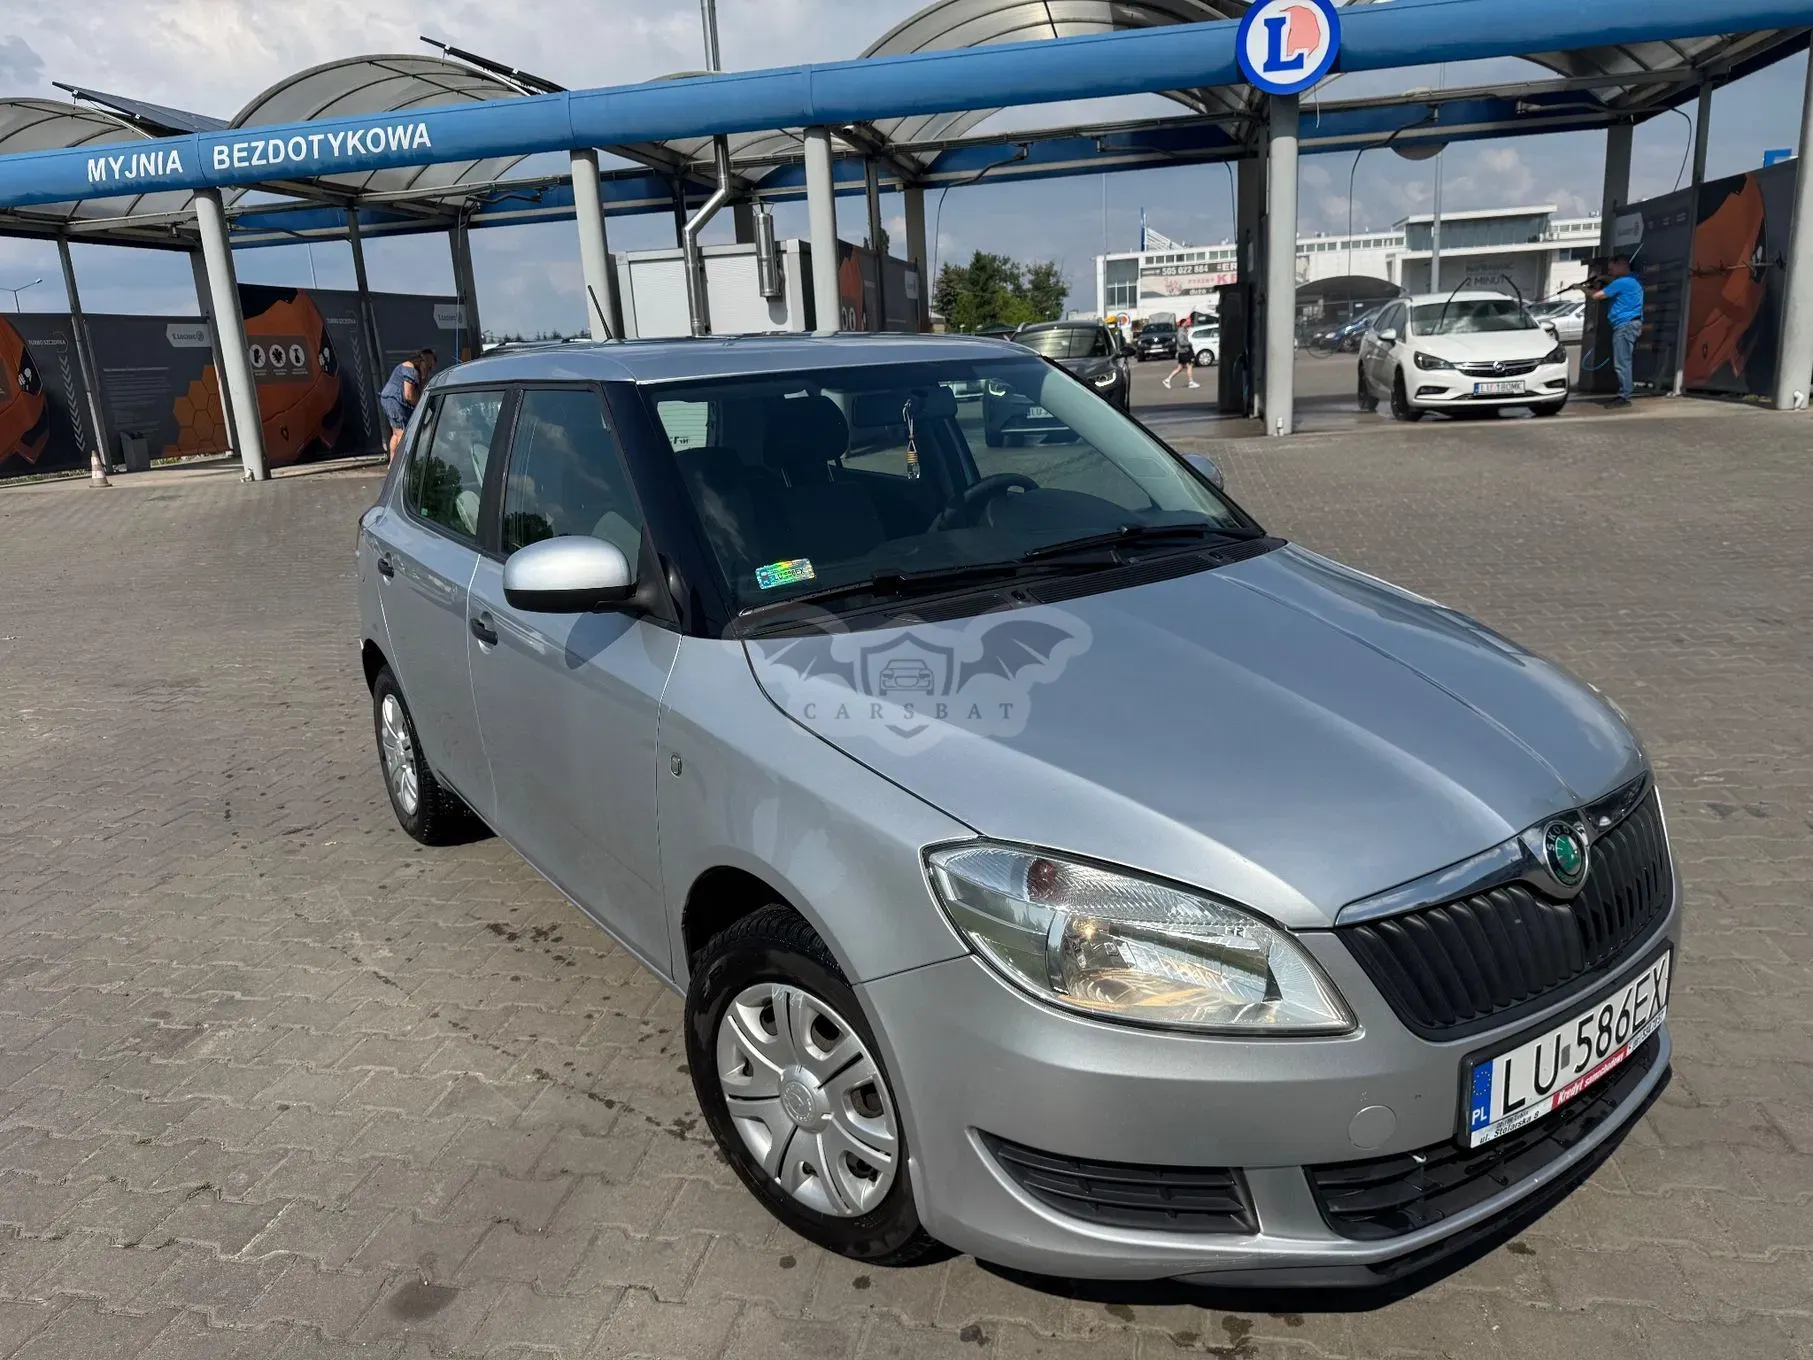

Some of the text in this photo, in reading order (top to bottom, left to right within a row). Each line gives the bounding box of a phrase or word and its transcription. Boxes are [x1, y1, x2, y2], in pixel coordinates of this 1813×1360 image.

[1263, 17, 1304, 73] L
[87, 122, 432, 183] MYJNIA BEZDOTYKOWA
[1472, 958, 1666, 1126] PL LU 586EX
[1557, 1079, 1584, 1105] Kredyt
[1480, 1133, 1490, 1144] ul.
